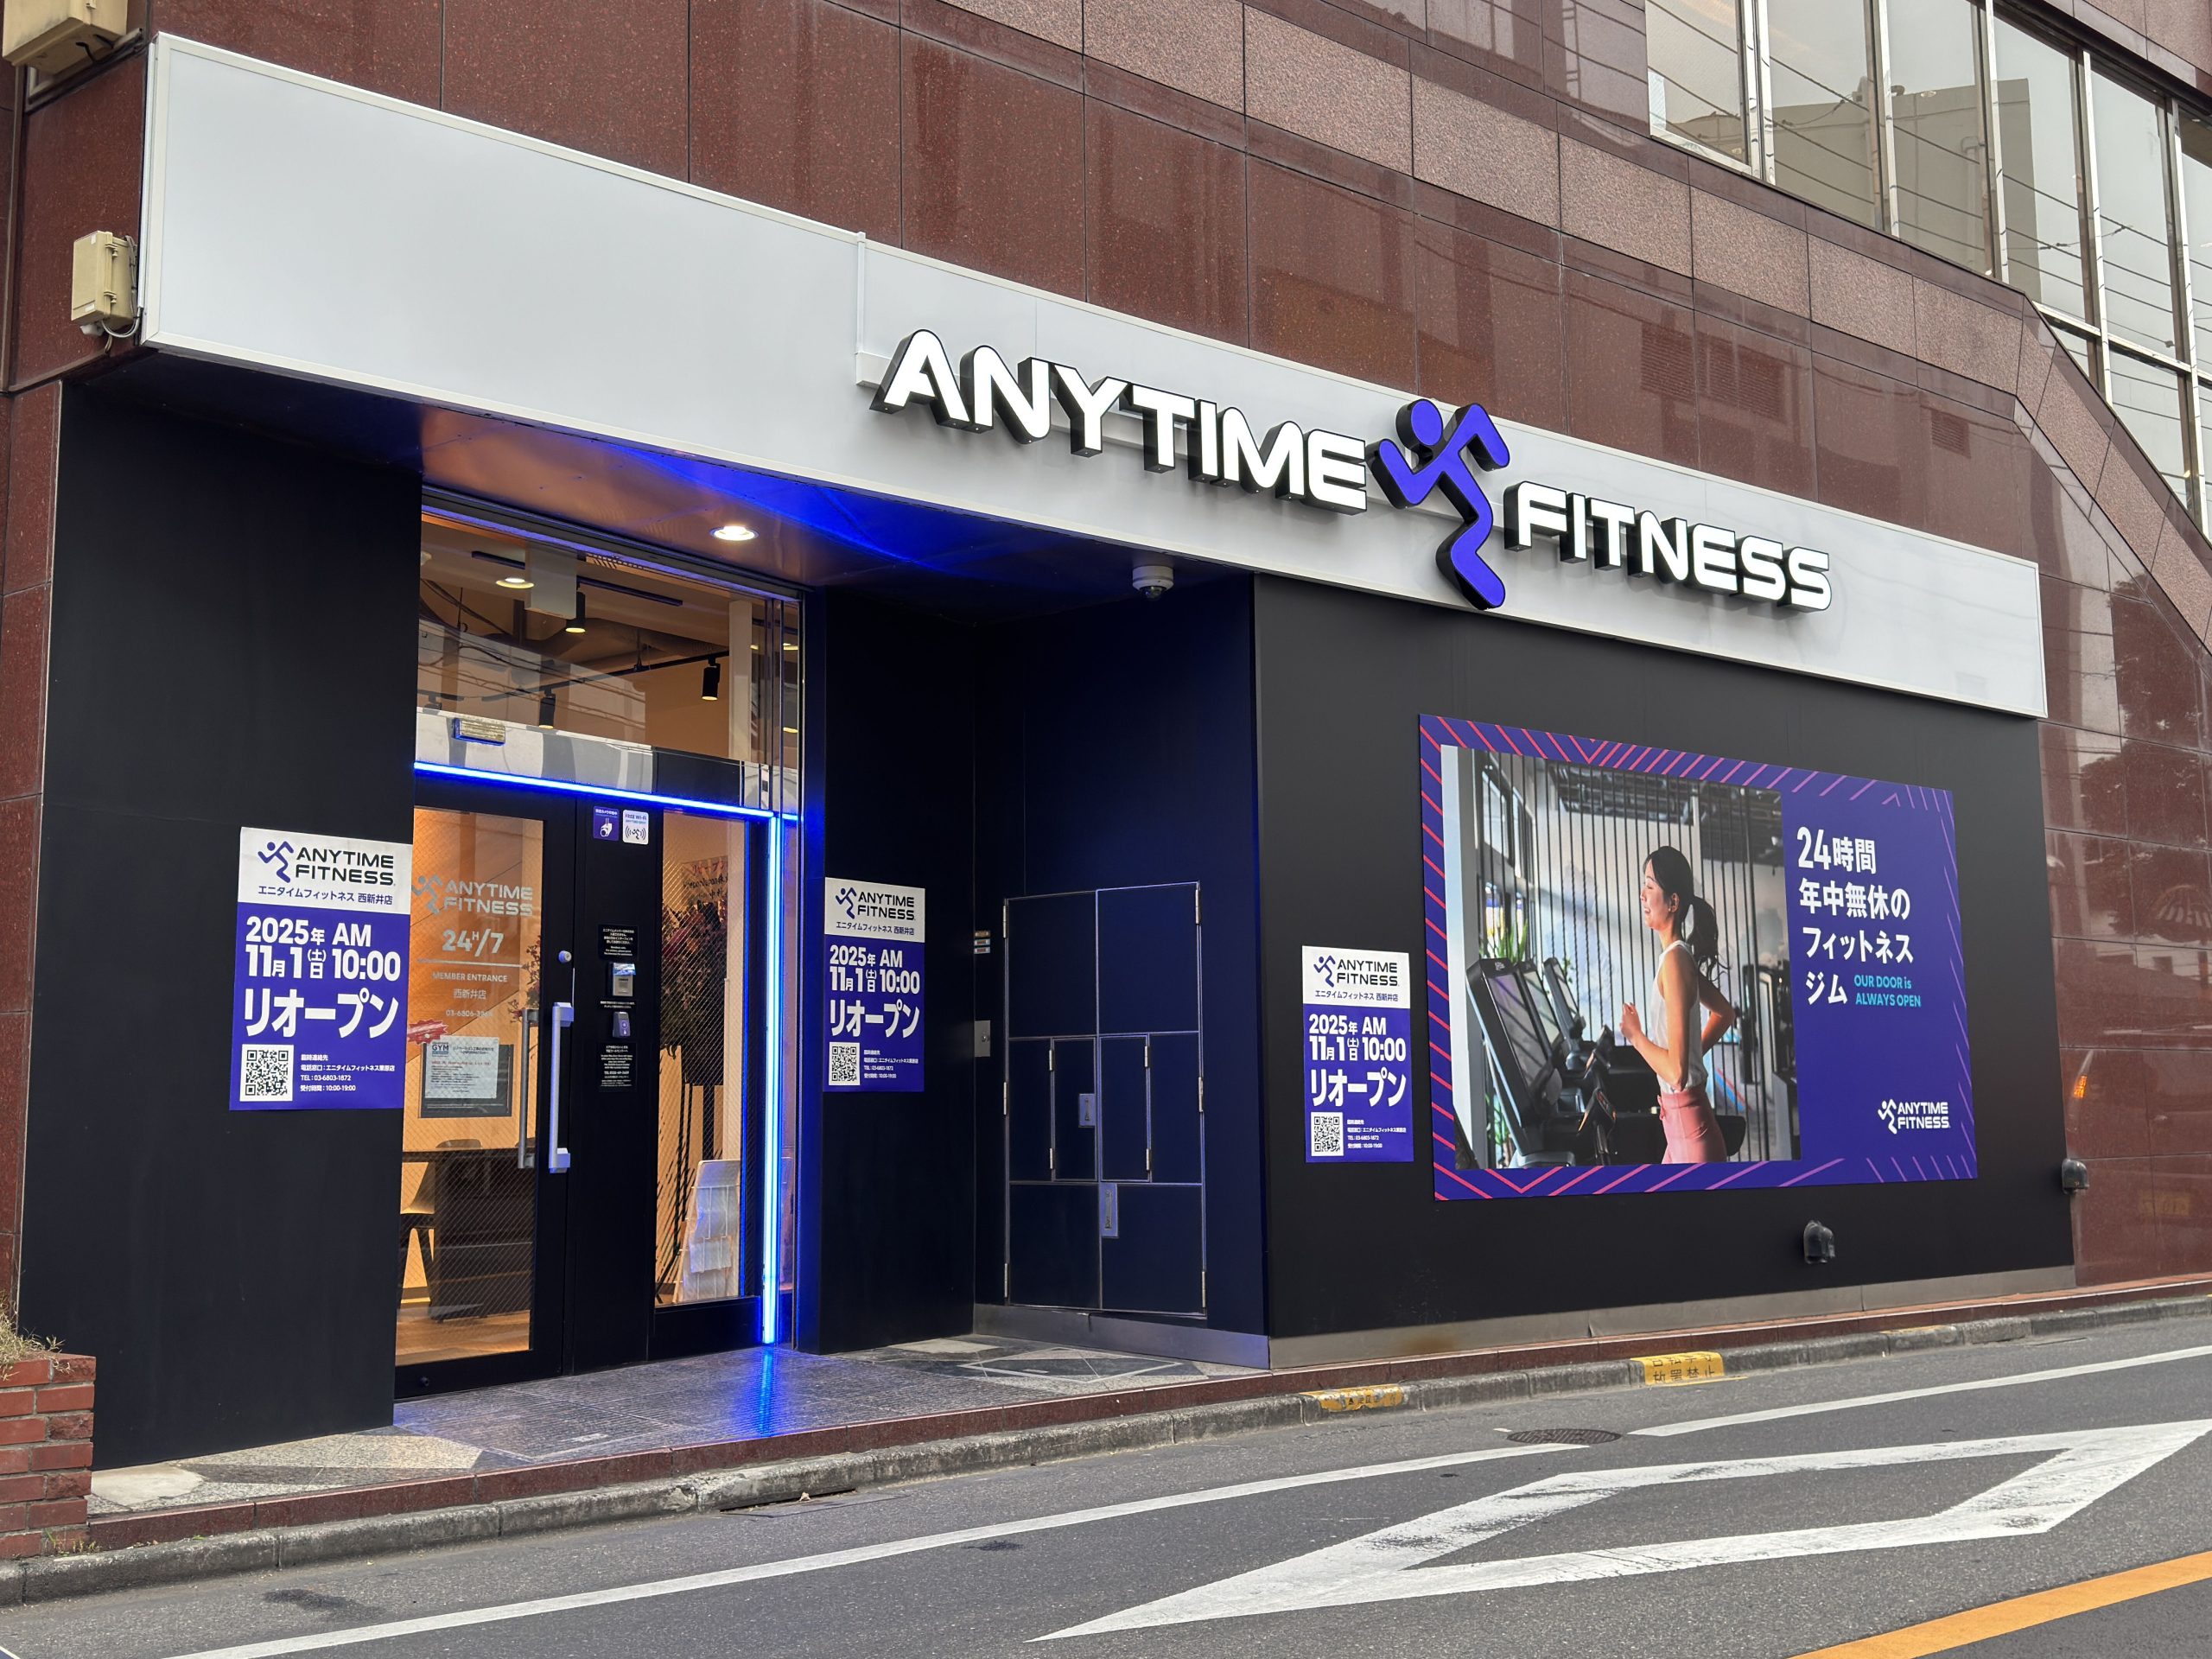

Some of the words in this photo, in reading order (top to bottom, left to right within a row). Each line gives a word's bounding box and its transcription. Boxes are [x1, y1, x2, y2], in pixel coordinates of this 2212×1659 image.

[876, 329, 1367, 512] ANYTIME
[1506, 481, 1830, 612] FITNESS
[296, 847, 394, 869] ANYTIME
[1796, 826, 1877, 874] 24時間
[296, 864, 394, 886] FITNESS
[257, 886, 354, 902] エニタイムフィットネス
[358, 892, 393, 906] 西新井店
[444, 880, 533, 900] ANYTIME
[858, 891, 914, 907] ANYTIME
[1799, 877, 1911, 920] 年中無休の
[444, 897, 533, 917] FITNESS
[857, 905, 915, 921] FITNESS
[245, 916, 325, 945] 2025年
[332, 923, 372, 947] AM
[836, 921, 893, 934] エニタイムフィットネス
[1802, 926, 1914, 964] フィットネス
[332, 949, 401, 982] 10:00
[830, 945, 876, 967] 2025年
[880, 949, 903, 969] AM
[1337, 959, 1398, 974] ANYTIME
[432, 971, 466, 981] MEMBER
[467, 973, 508, 982] ENTRANCE
[880, 969, 920, 995] 10:00
[1337, 972, 1399, 987] FITNESS
[1853, 975, 1875, 989] OUR
[1876, 976, 1904, 989] DOOR
[1904, 976, 1912, 990] is
[1315, 990, 1375, 1001] エニタイムフィットネス
[1805, 970, 1848, 1006] ジム
[1855, 995, 1896, 1007] ALWAYS
[1896, 995, 1921, 1008] OPEN
[244, 987, 399, 1039] リオープン
[830, 998, 920, 1038] リオープン
[1309, 1014, 1358, 1035] 2025年
[1362, 1016, 1387, 1036] AM
[1362, 1037, 1407, 1062] 10:00
[1310, 1066, 1407, 1108] リオープン
[1897, 1100, 1949, 1116] ANYTIME
[1897, 1115, 1950, 1129] FITNESS
